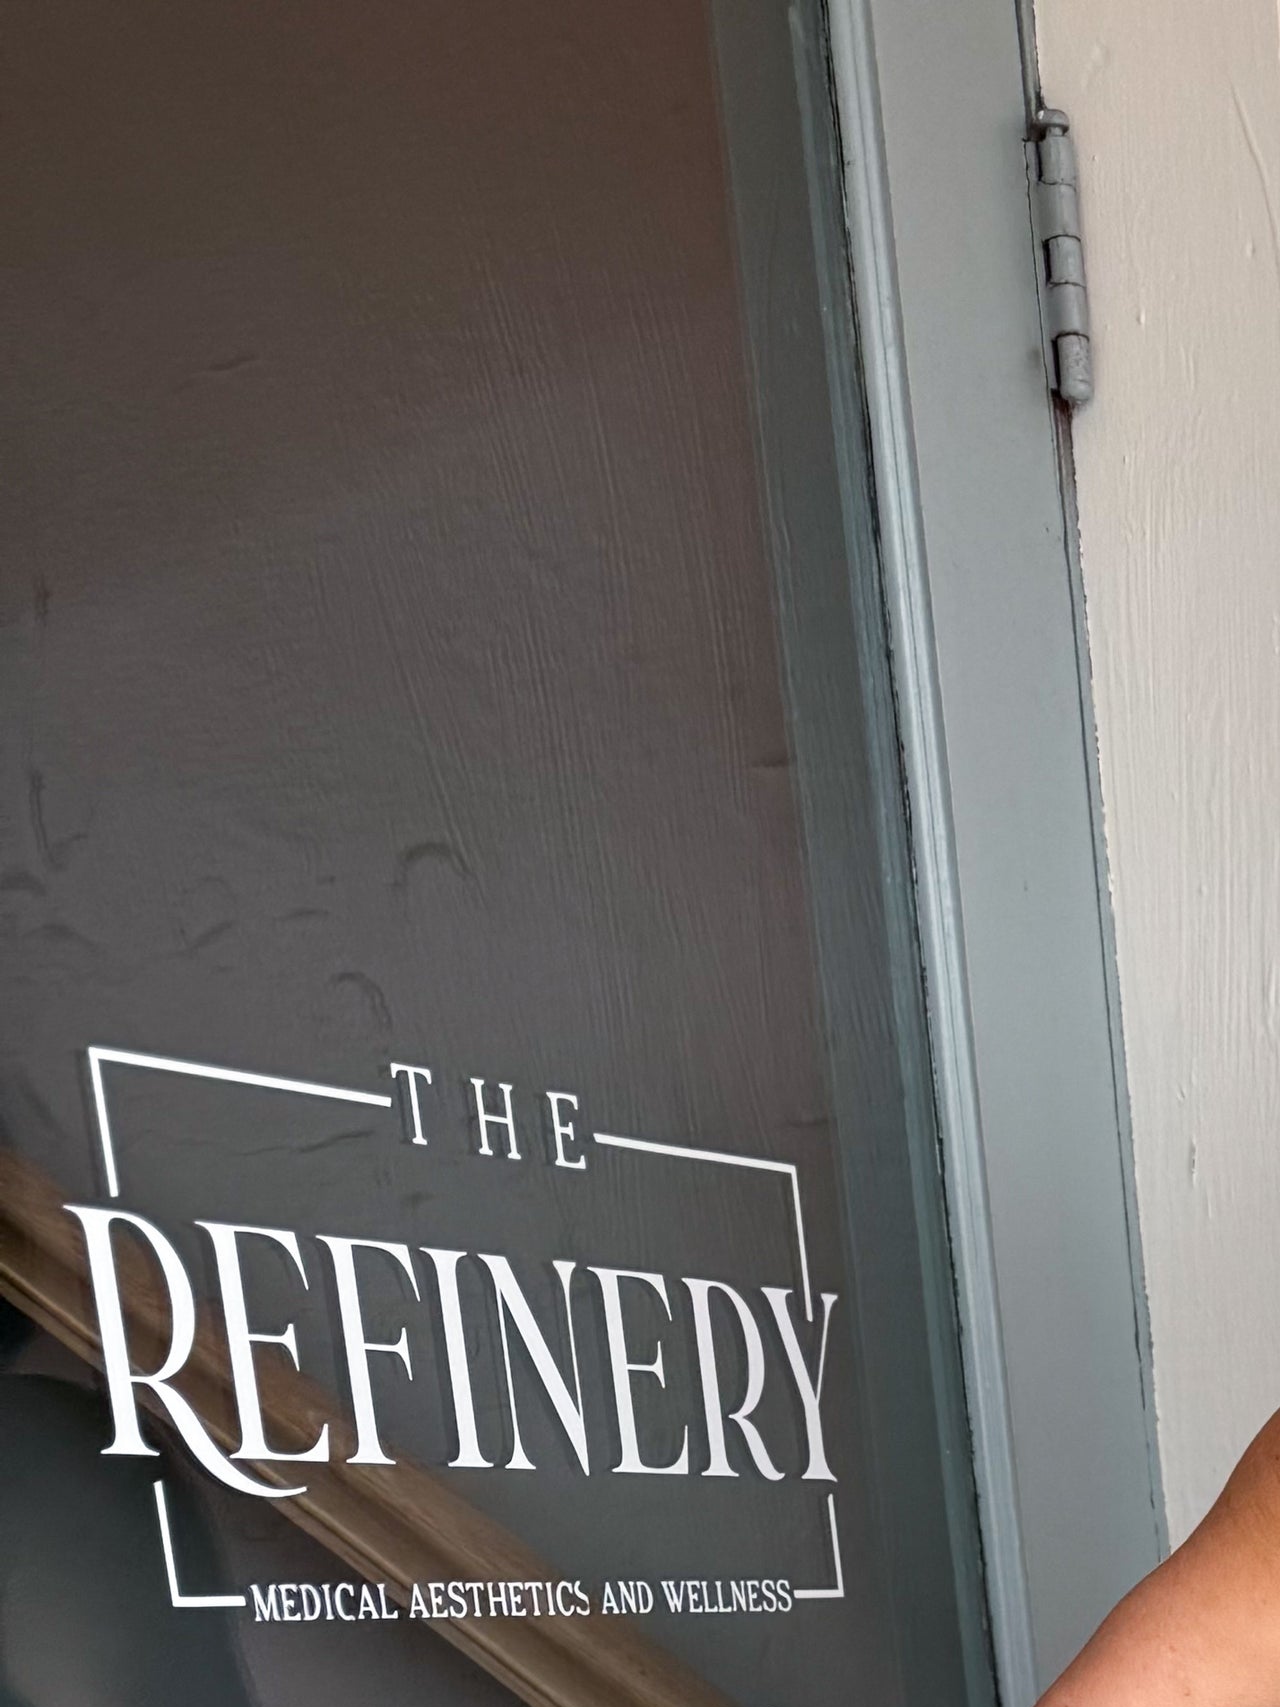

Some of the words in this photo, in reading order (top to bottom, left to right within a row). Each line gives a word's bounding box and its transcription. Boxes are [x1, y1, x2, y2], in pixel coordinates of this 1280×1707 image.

[390, 1062, 587, 1170] THE
[62, 1203, 839, 1499] REFINERY
[250, 1583, 399, 1622] MEDICAL
[409, 1581, 591, 1619] AESTHETICS
[602, 1581, 655, 1615] AND
[661, 1579, 793, 1613] WELLNESS
